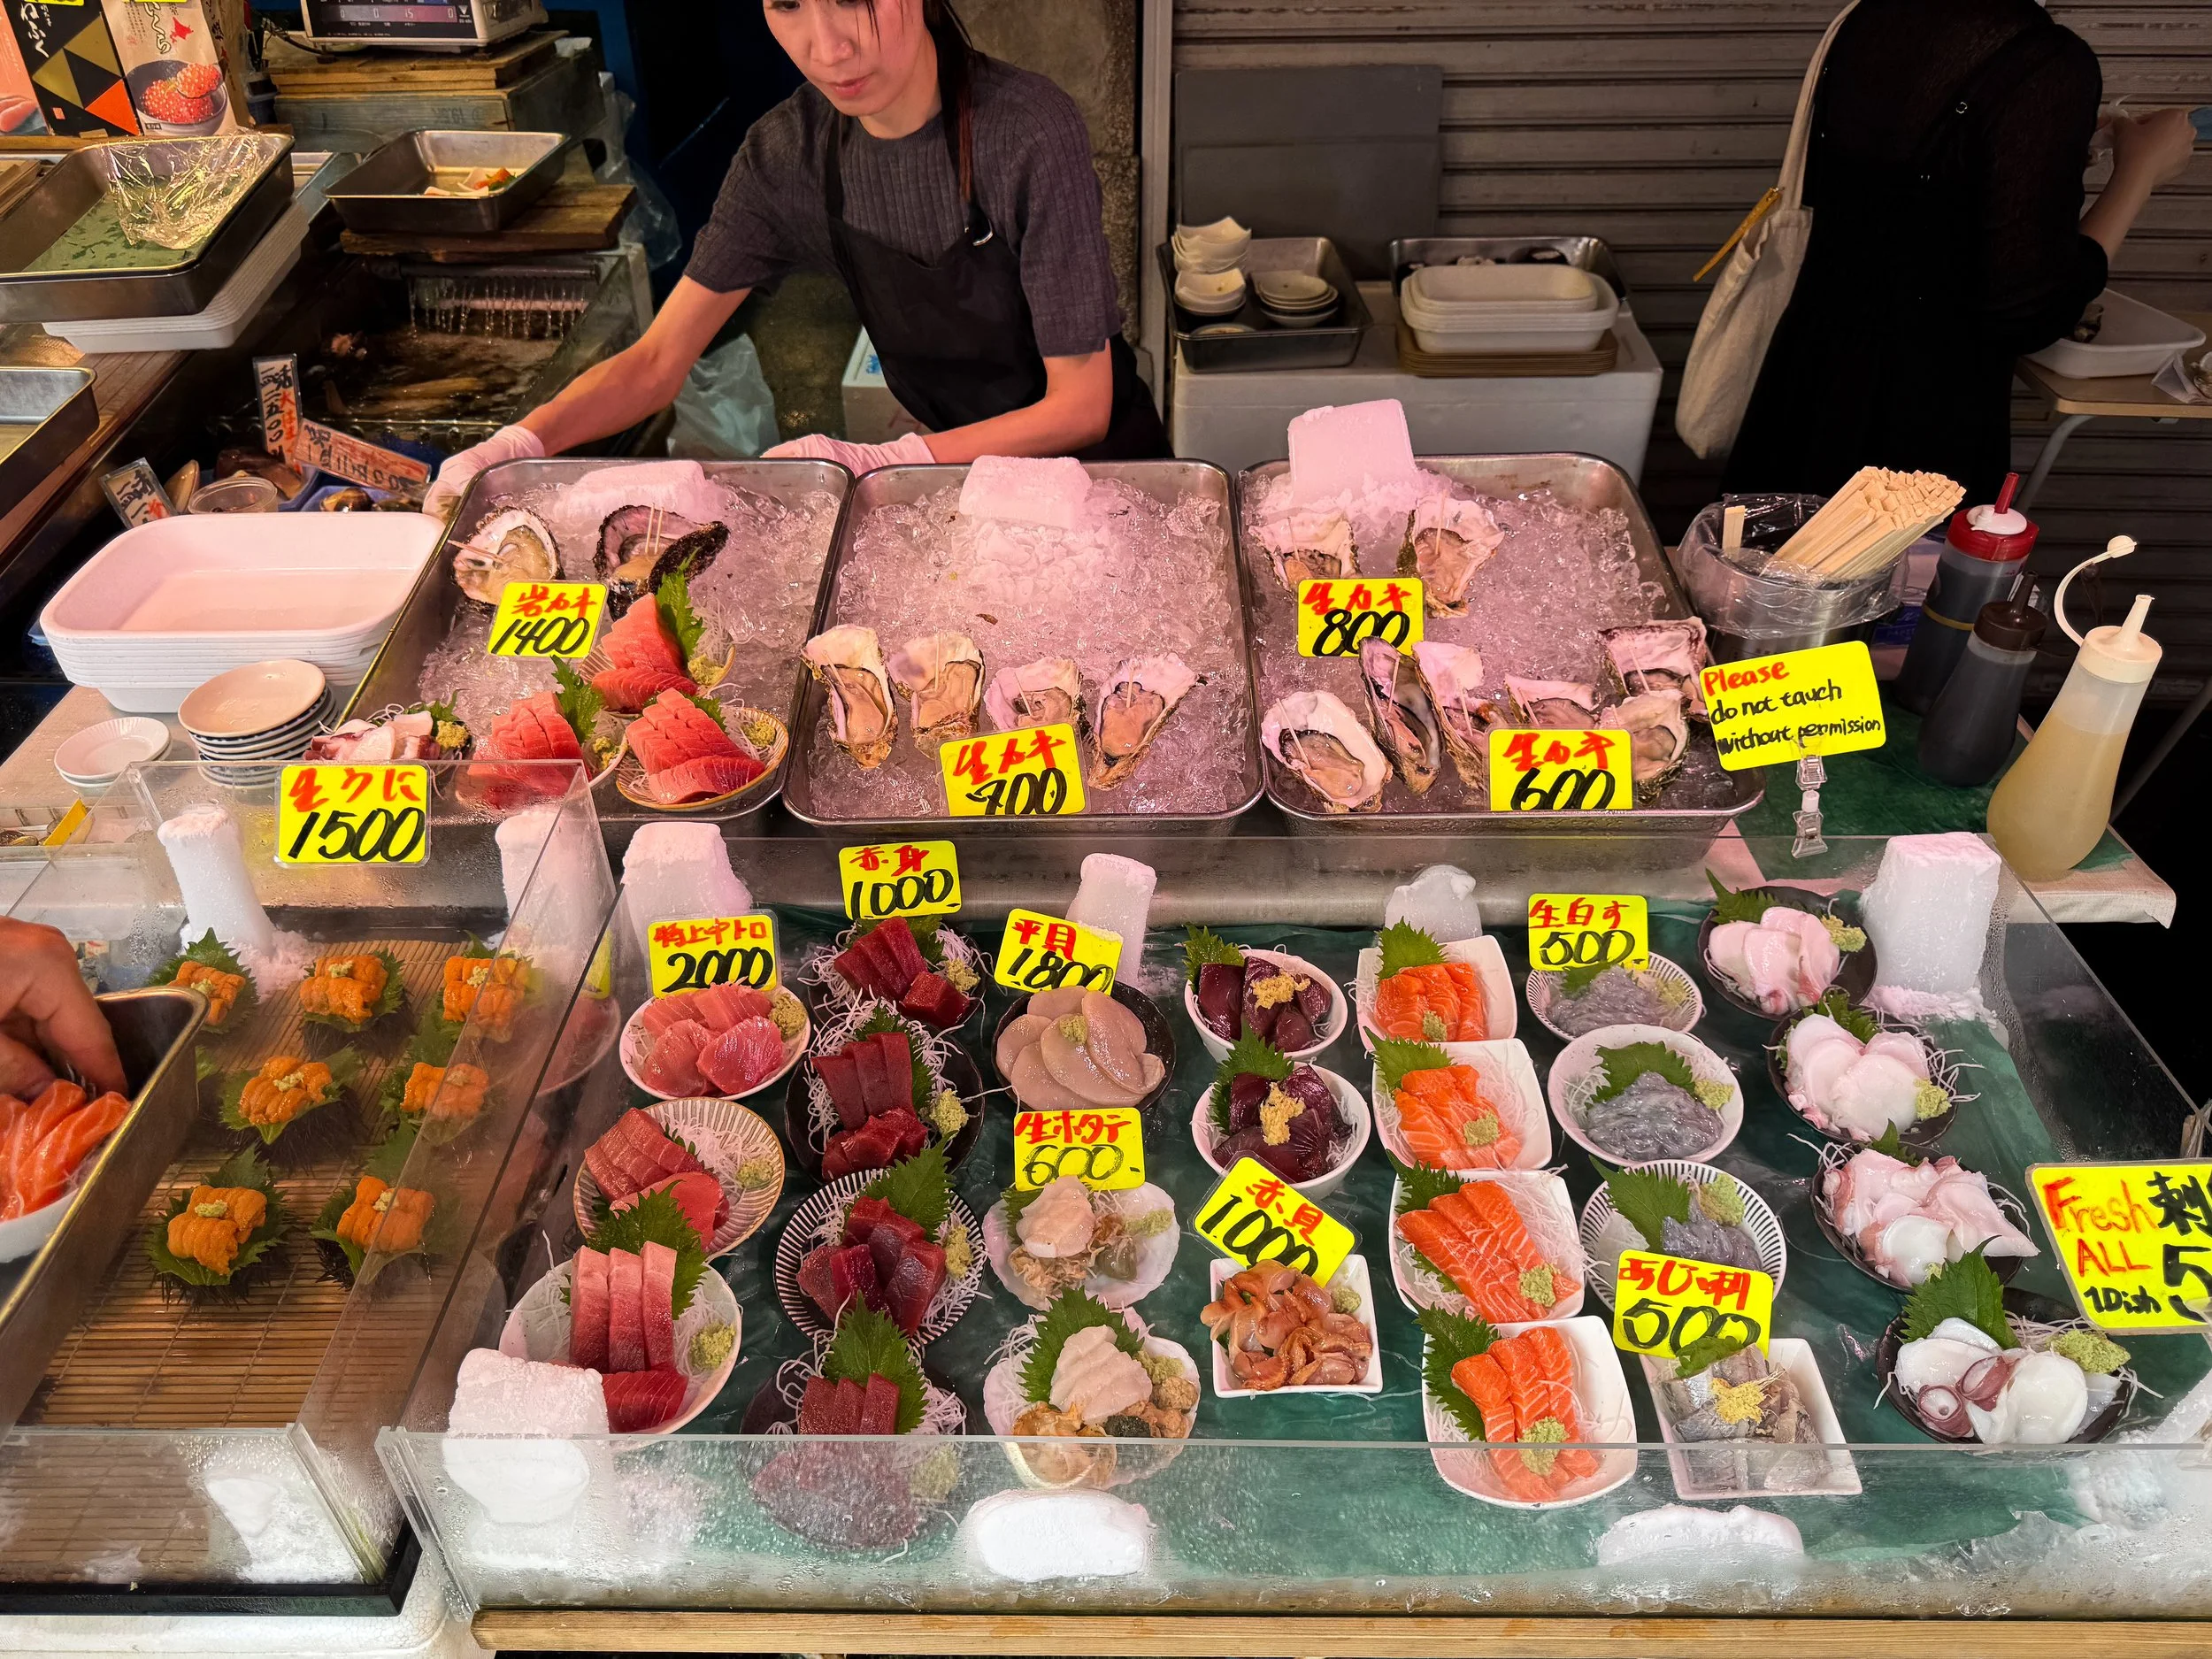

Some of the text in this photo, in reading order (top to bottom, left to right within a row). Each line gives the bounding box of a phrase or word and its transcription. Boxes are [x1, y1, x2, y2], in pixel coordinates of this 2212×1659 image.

[1302, 582, 1412, 615] 生カキ
[490, 617, 590, 655] 1400
[1312, 608, 1410, 657] 800
[1703, 661, 1791, 696] Please
[1710, 699, 1738, 726] do
[1741, 695, 1778, 717] not
[953, 730, 1067, 786] 生カキ
[1502, 731, 1616, 772] 生カキ
[1509, 767, 1616, 810] 600
[288, 807, 426, 862] 1500
[849, 845, 930, 877] 赤身
[1011, 918, 1078, 962] 平貝
[661, 946, 774, 993] 2000
[1014, 1110, 1133, 1144] 生ホタテ
[1245, 1179, 1325, 1247] 赤貝
[2042, 1177, 2160, 1234] Fresh
[2146, 1171, 2212, 1239] 刺
[2077, 1238, 2154, 1278] ALL
[1622, 1297, 1762, 1355] 500
